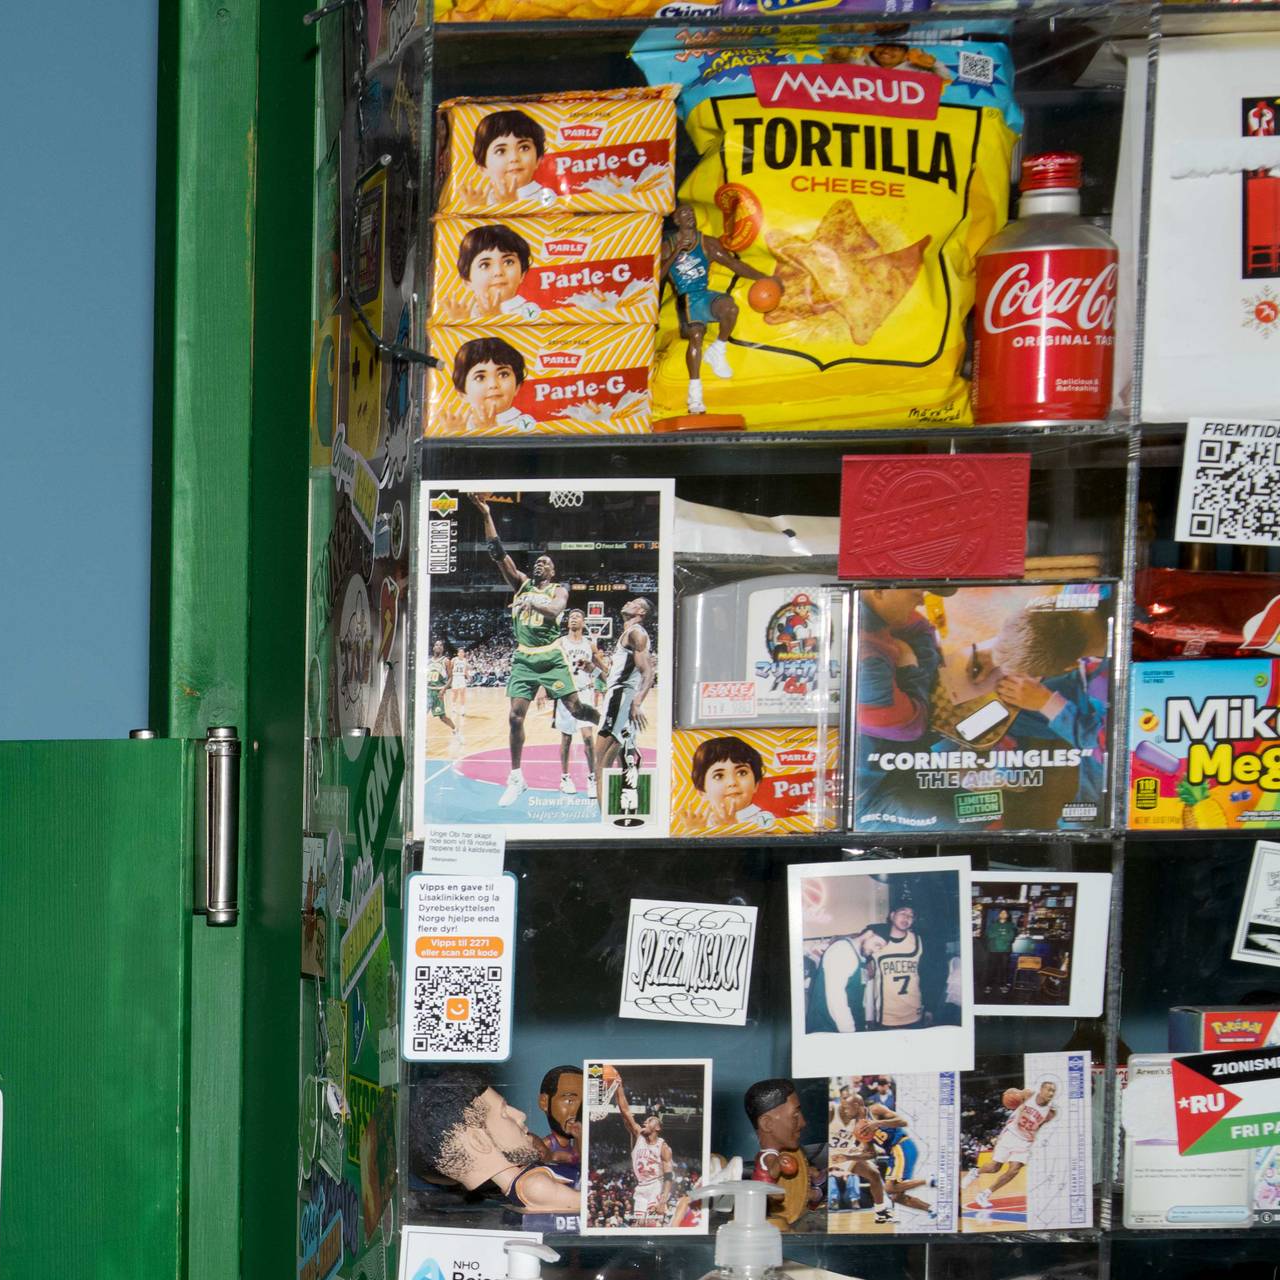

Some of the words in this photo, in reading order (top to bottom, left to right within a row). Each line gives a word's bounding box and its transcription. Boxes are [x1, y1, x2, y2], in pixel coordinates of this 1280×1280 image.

[770, 71, 925, 106] MAARUD
[563, 127, 601, 138] PARLE
[555, 148, 648, 176] Parle-G
[734, 117, 958, 194] TORTILLA
[791, 176, 907, 198] CHEESE
[548, 243, 584, 253] PARLE
[539, 264, 633, 290] Parle-G
[543, 355, 578, 364] PARLE
[534, 376, 626, 401] Parle-G
[1165, 695, 1280, 743] Mik
[917, 771, 959, 790] THE
[961, 770, 1044, 790] ALBUM
[957, 793, 1000, 806] LIMITED
[958, 803, 1000, 815] EDITION
[419, 883, 445, 892] Vipps
[461, 885, 483, 893] gave
[419, 894, 476, 902] Lisaklinikken
[477, 895, 490, 903] og
[418, 904, 496, 913] Dyrebeskyttelsen
[418, 915, 446, 923] Norge
[448, 914, 475, 923] hjelpe
[417, 925, 438, 933] flere
[431, 938, 456, 947] Vipps
[882, 960, 918, 975] PACERS
[893, 975, 911, 996] 7
[1230, 1124, 1259, 1140] FRI
[453, 1260, 480, 1270] NHO
